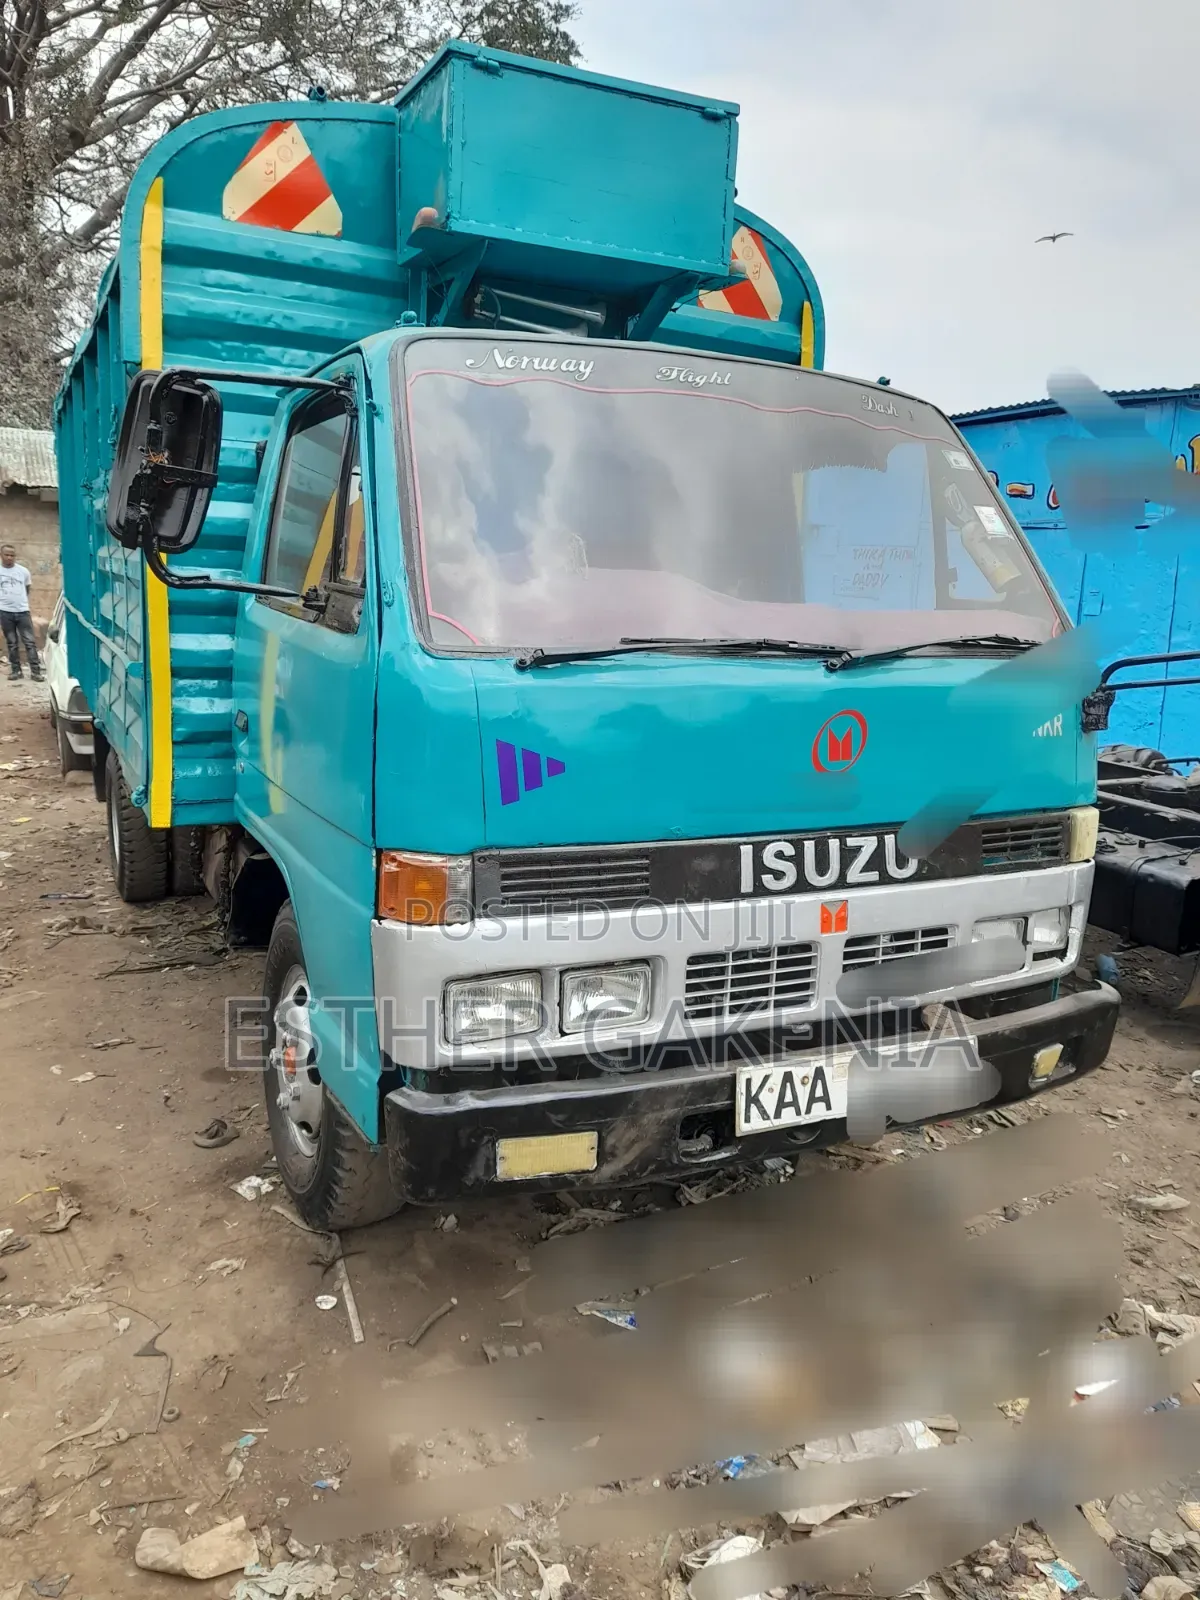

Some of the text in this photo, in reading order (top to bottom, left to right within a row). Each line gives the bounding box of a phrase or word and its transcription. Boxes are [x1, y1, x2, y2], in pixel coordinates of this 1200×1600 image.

[465, 348, 899, 417] Norway Flight Dash
[739, 834, 919, 894] ISUZU
[743, 1065, 833, 1124] KAA
